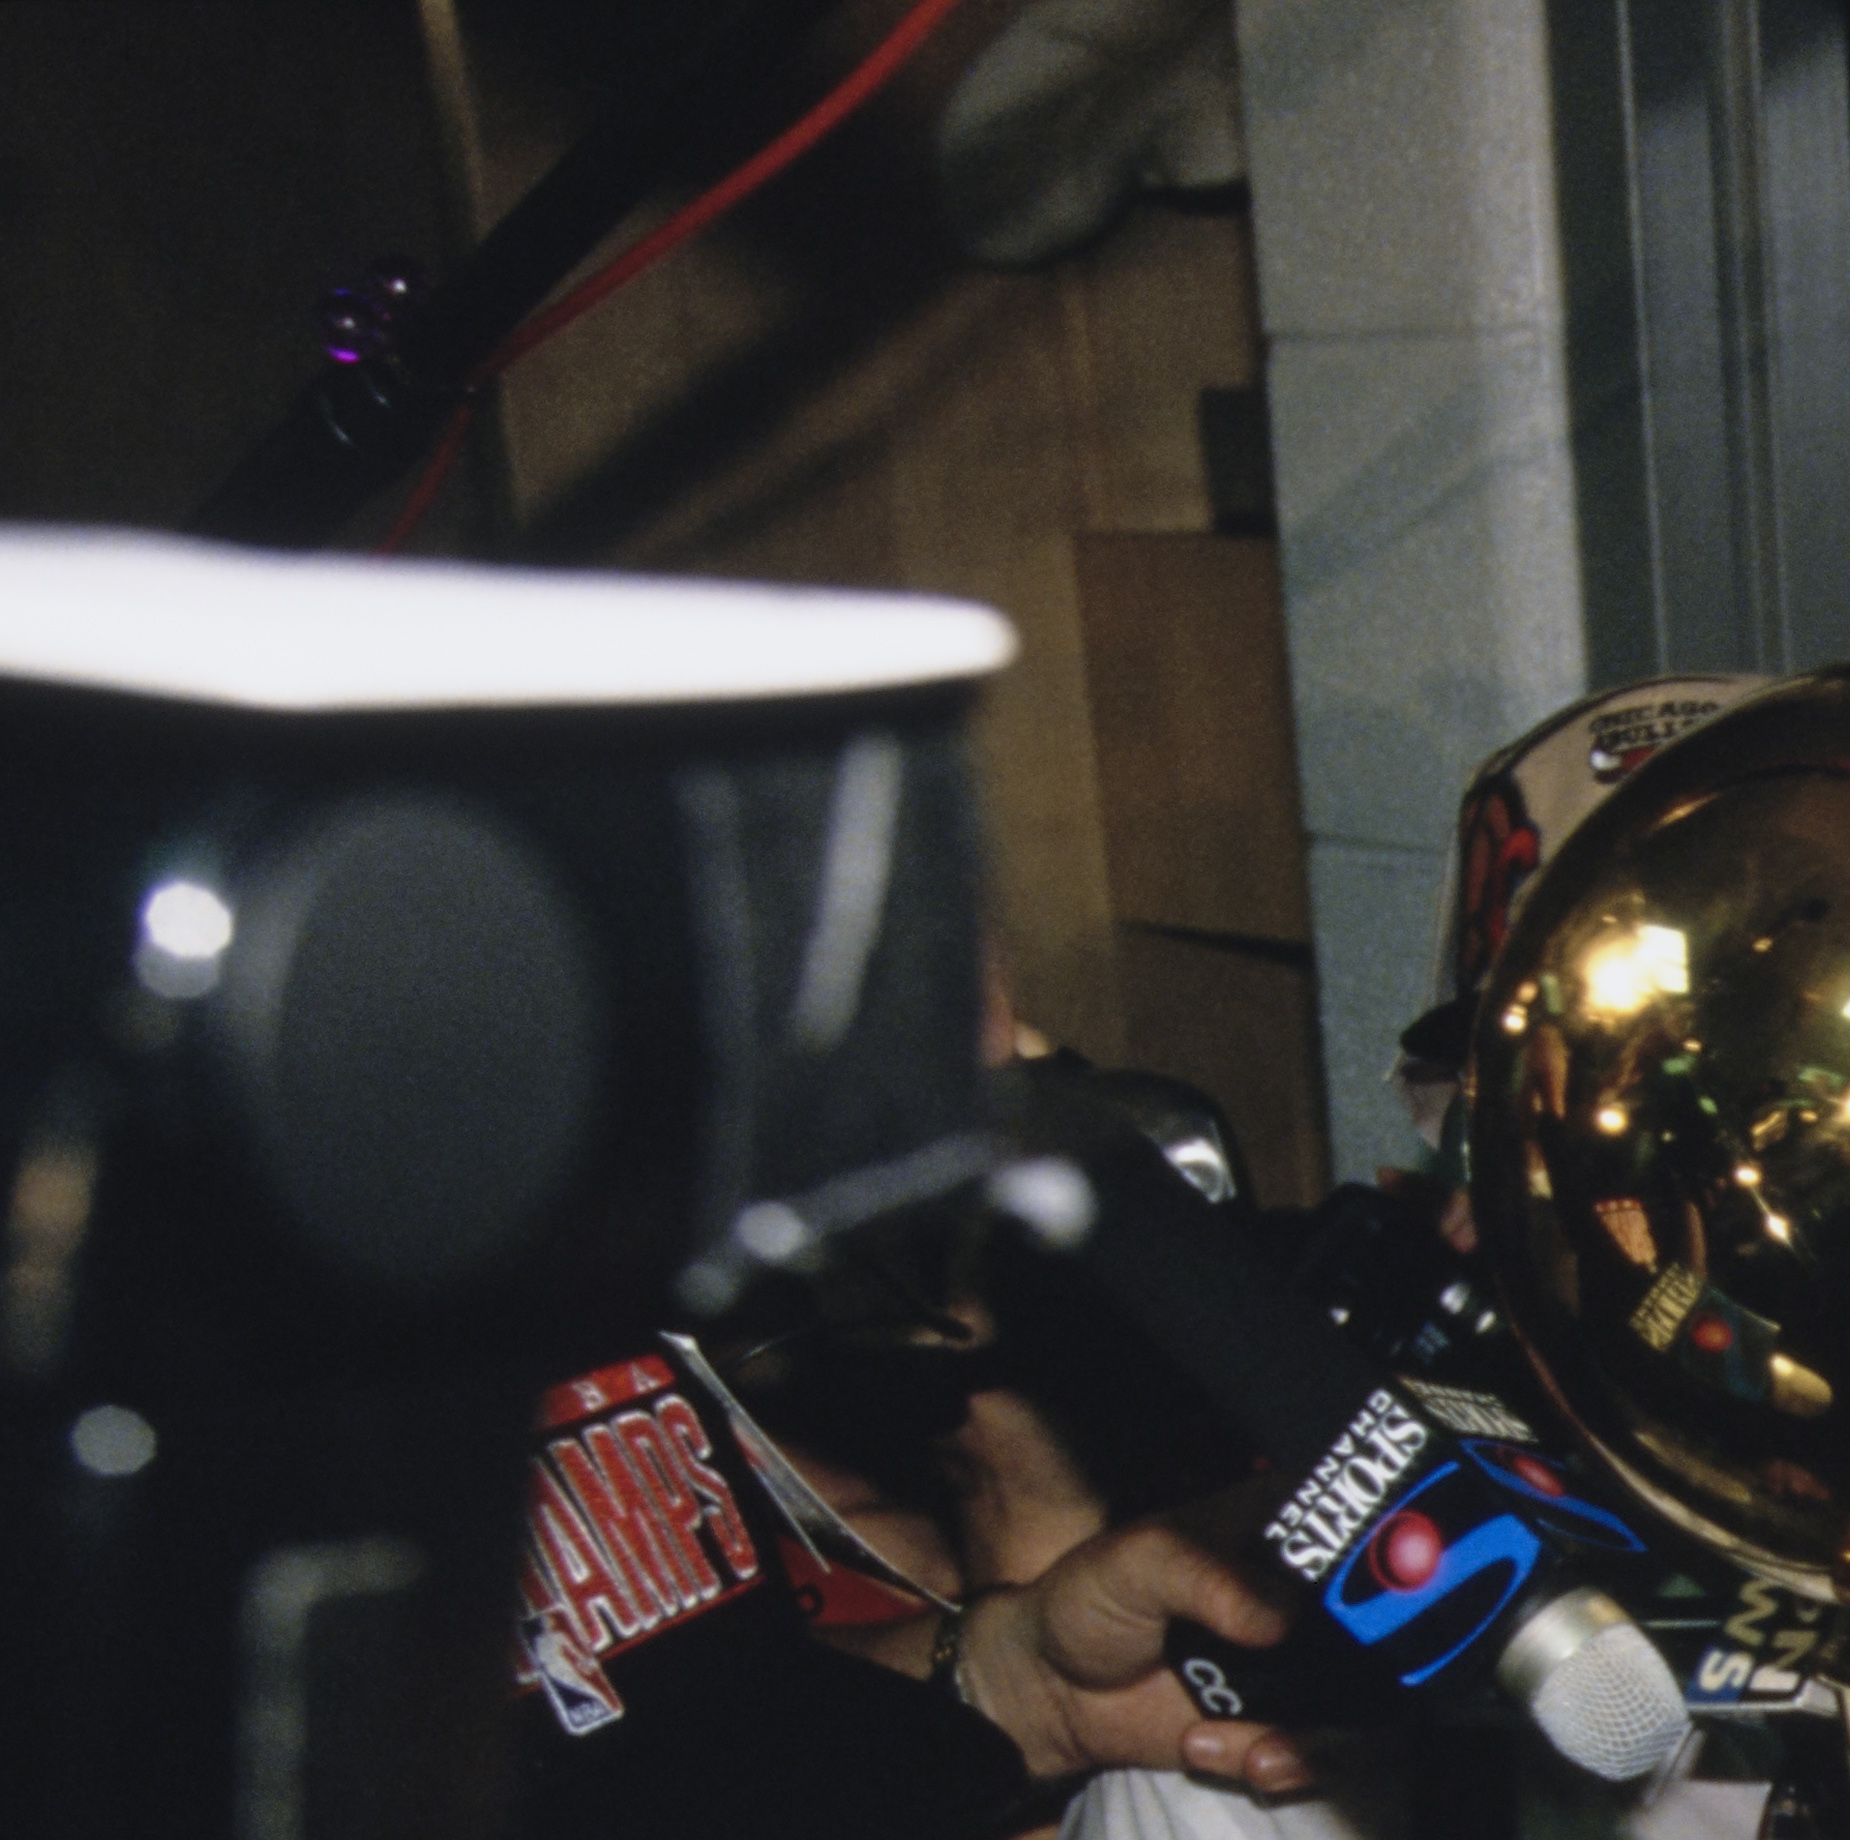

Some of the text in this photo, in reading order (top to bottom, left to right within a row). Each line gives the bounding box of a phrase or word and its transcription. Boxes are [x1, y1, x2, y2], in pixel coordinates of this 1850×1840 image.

[526, 1393, 760, 1658] AMPS
[1263, 1388, 1393, 1541] CHANNEL
[1280, 1406, 1428, 1582] SPORTS
